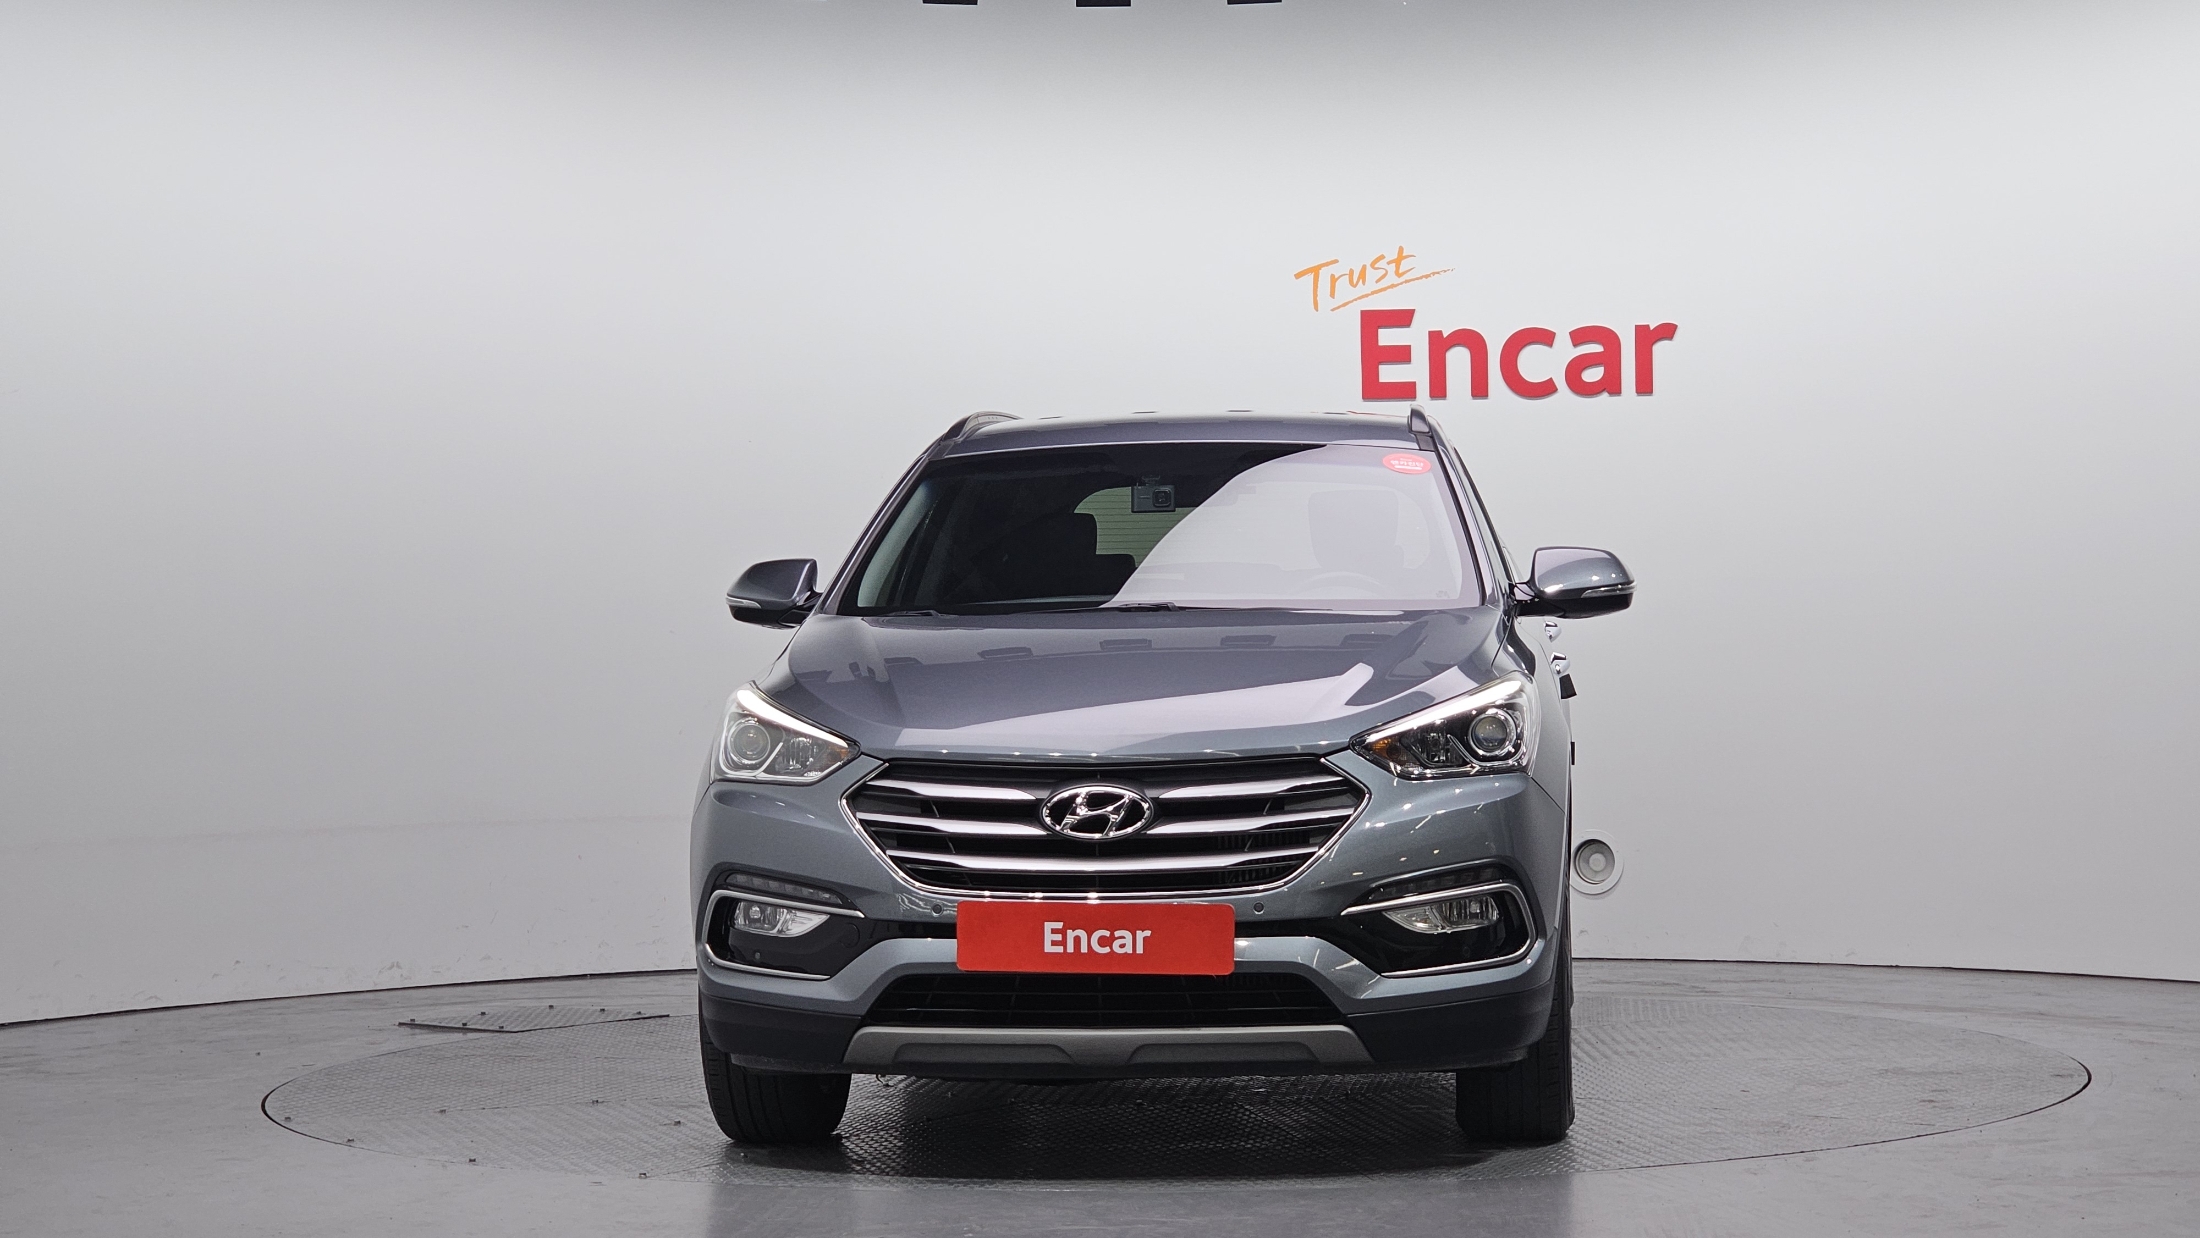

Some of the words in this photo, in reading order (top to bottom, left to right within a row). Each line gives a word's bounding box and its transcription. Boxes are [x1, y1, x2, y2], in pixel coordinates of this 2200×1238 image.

[1293, 245, 1417, 312] Trust
[1360, 308, 1679, 401] Encar
[1043, 921, 1152, 954] Encar
